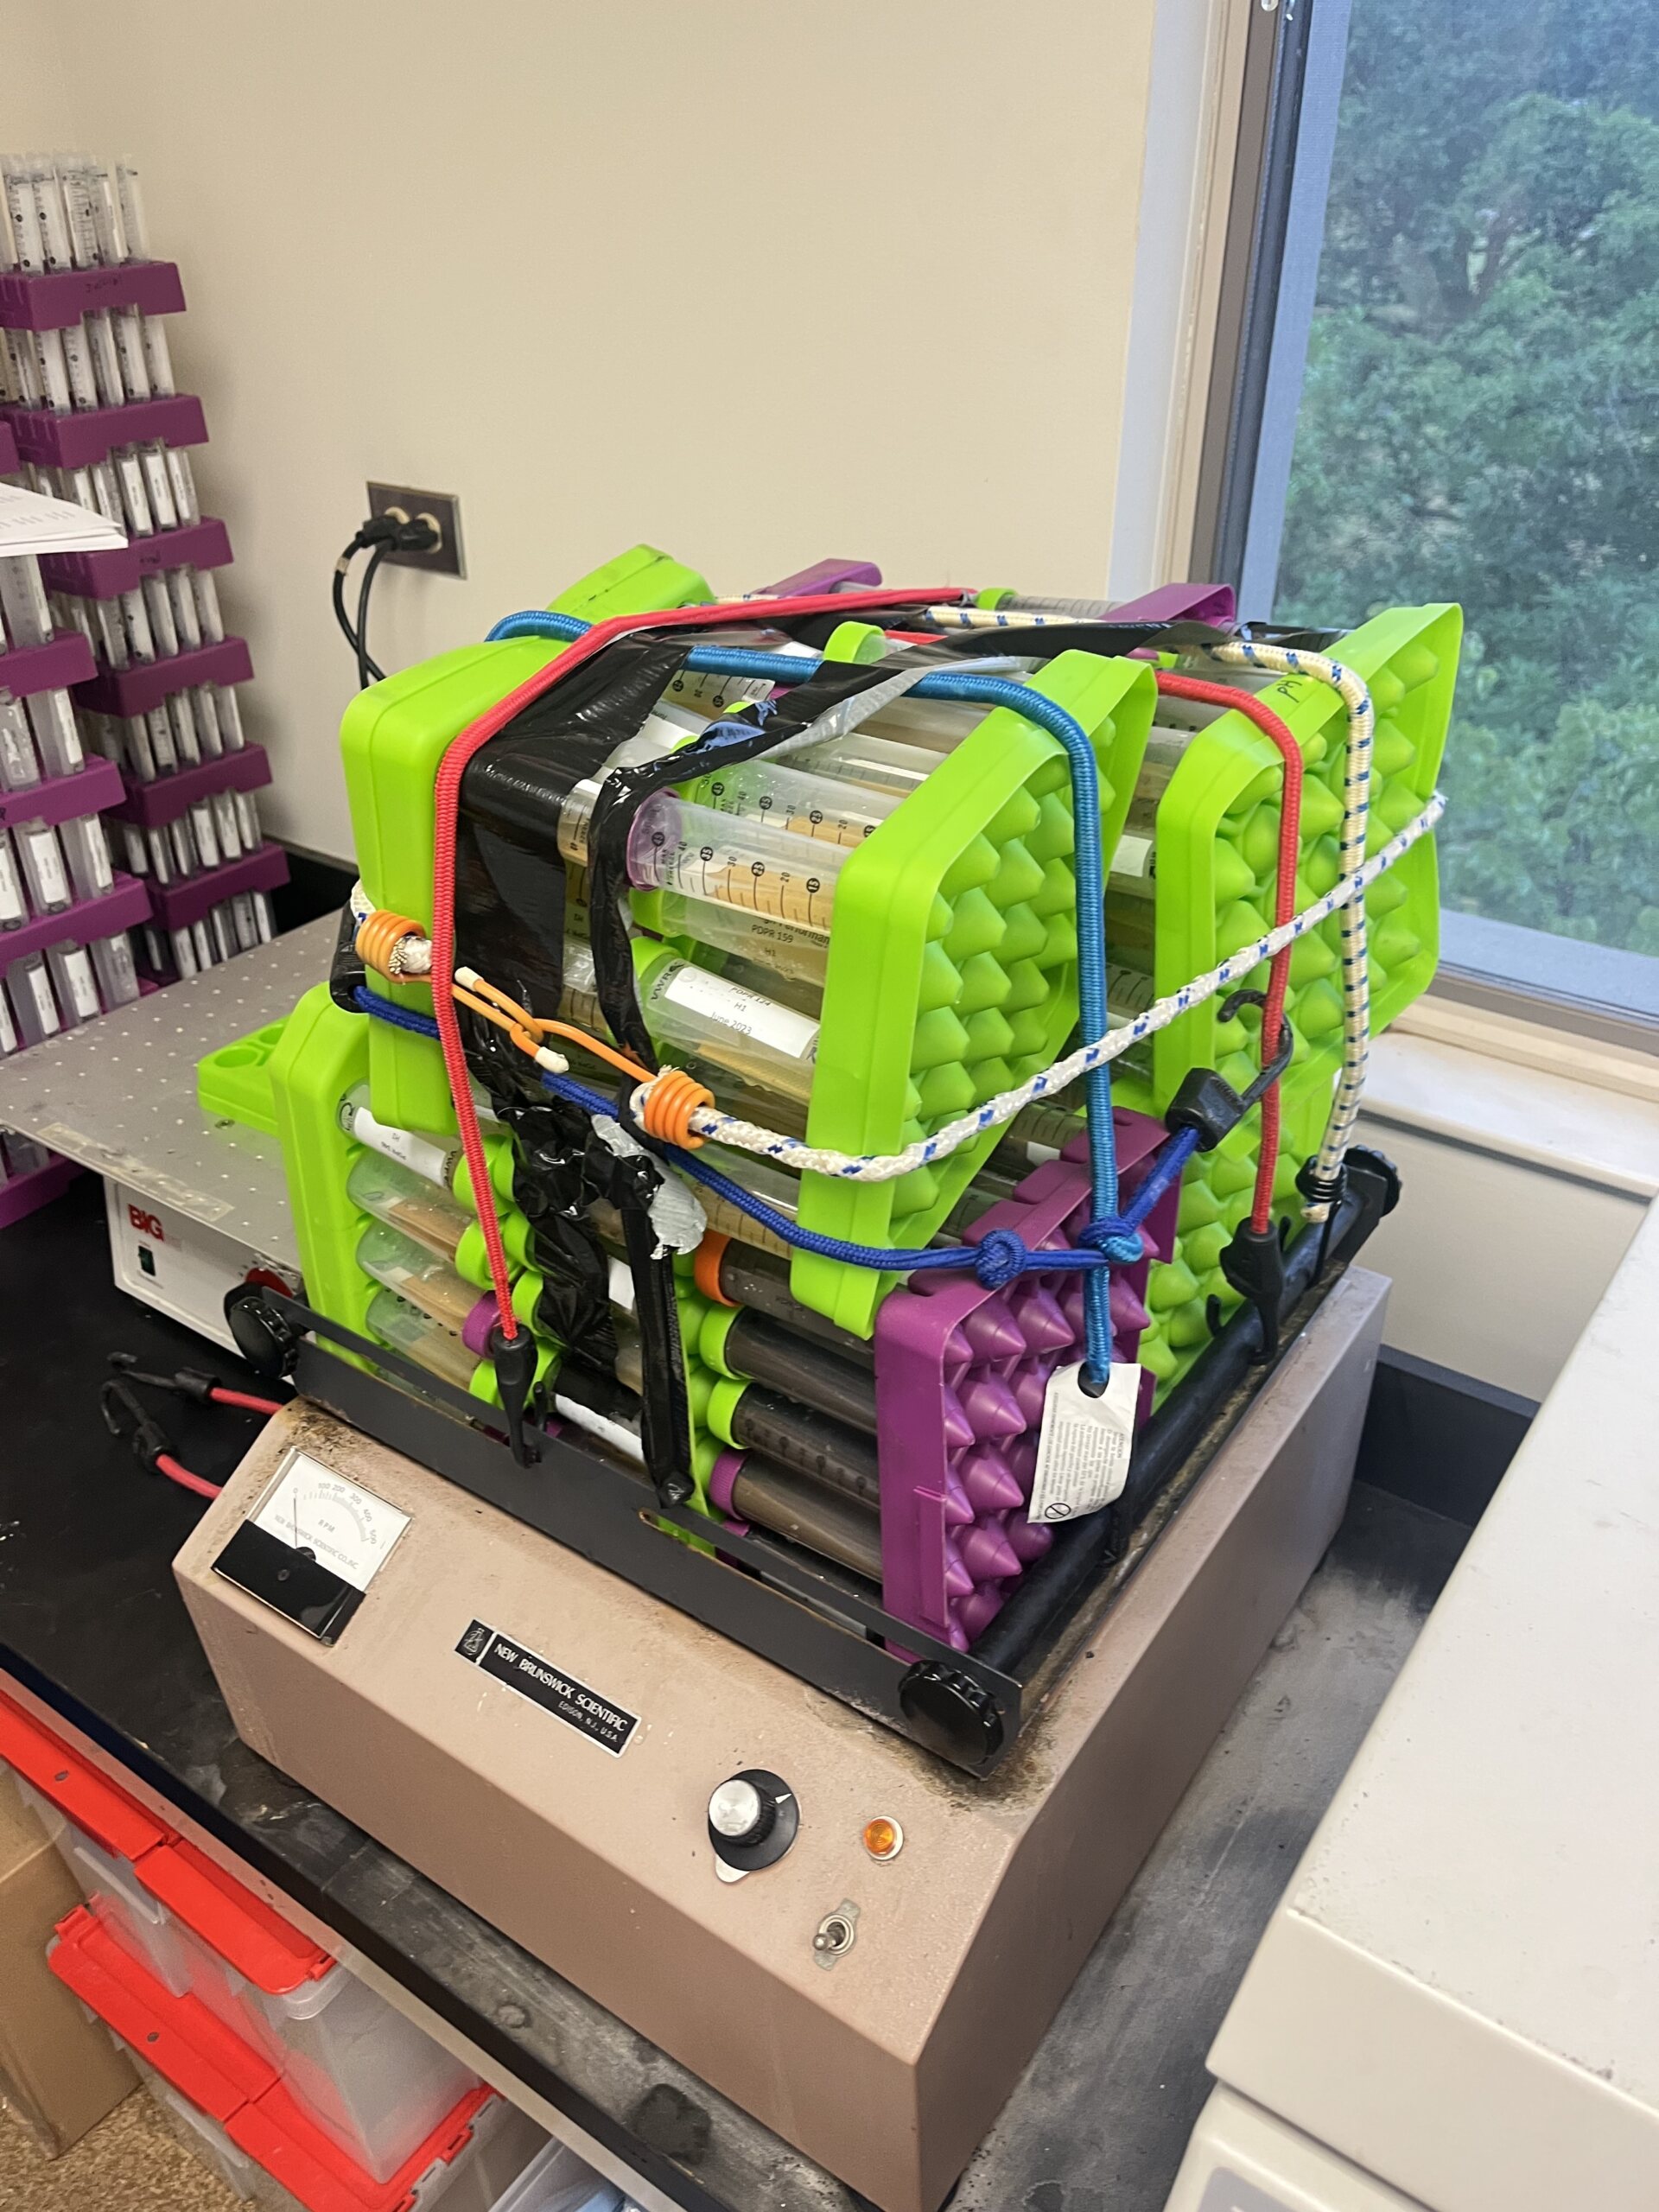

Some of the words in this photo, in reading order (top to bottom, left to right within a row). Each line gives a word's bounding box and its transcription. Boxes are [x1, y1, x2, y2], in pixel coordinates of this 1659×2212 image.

[759, 796, 772, 810] 35
[785, 805, 796, 815] 30
[810, 810, 823, 824] 25
[838, 819, 848, 830] 20
[678, 841, 688, 852] 40
[700, 846, 714, 861] 35
[728, 856, 737, 867] 30
[751, 861, 766, 877] 25
[781, 872, 791, 882] 20
[805, 877, 821, 893] 15
[751, 924, 775, 940] PDPR
[777, 930, 794, 944] 159
[651, 971, 671, 1001] VWR
[734, 1001, 747, 1012] H1
[711, 1012, 730, 1027] June
[732, 1020, 753, 1035] 2023
[332, 1484, 346, 1493] 200
[349, 1492, 362, 1504] 300
[493, 1643, 519, 1663] NEW
[518, 1658, 576, 1699] BRUNSWICK
[575, 1694, 628, 1732] SCIENTIFIC
